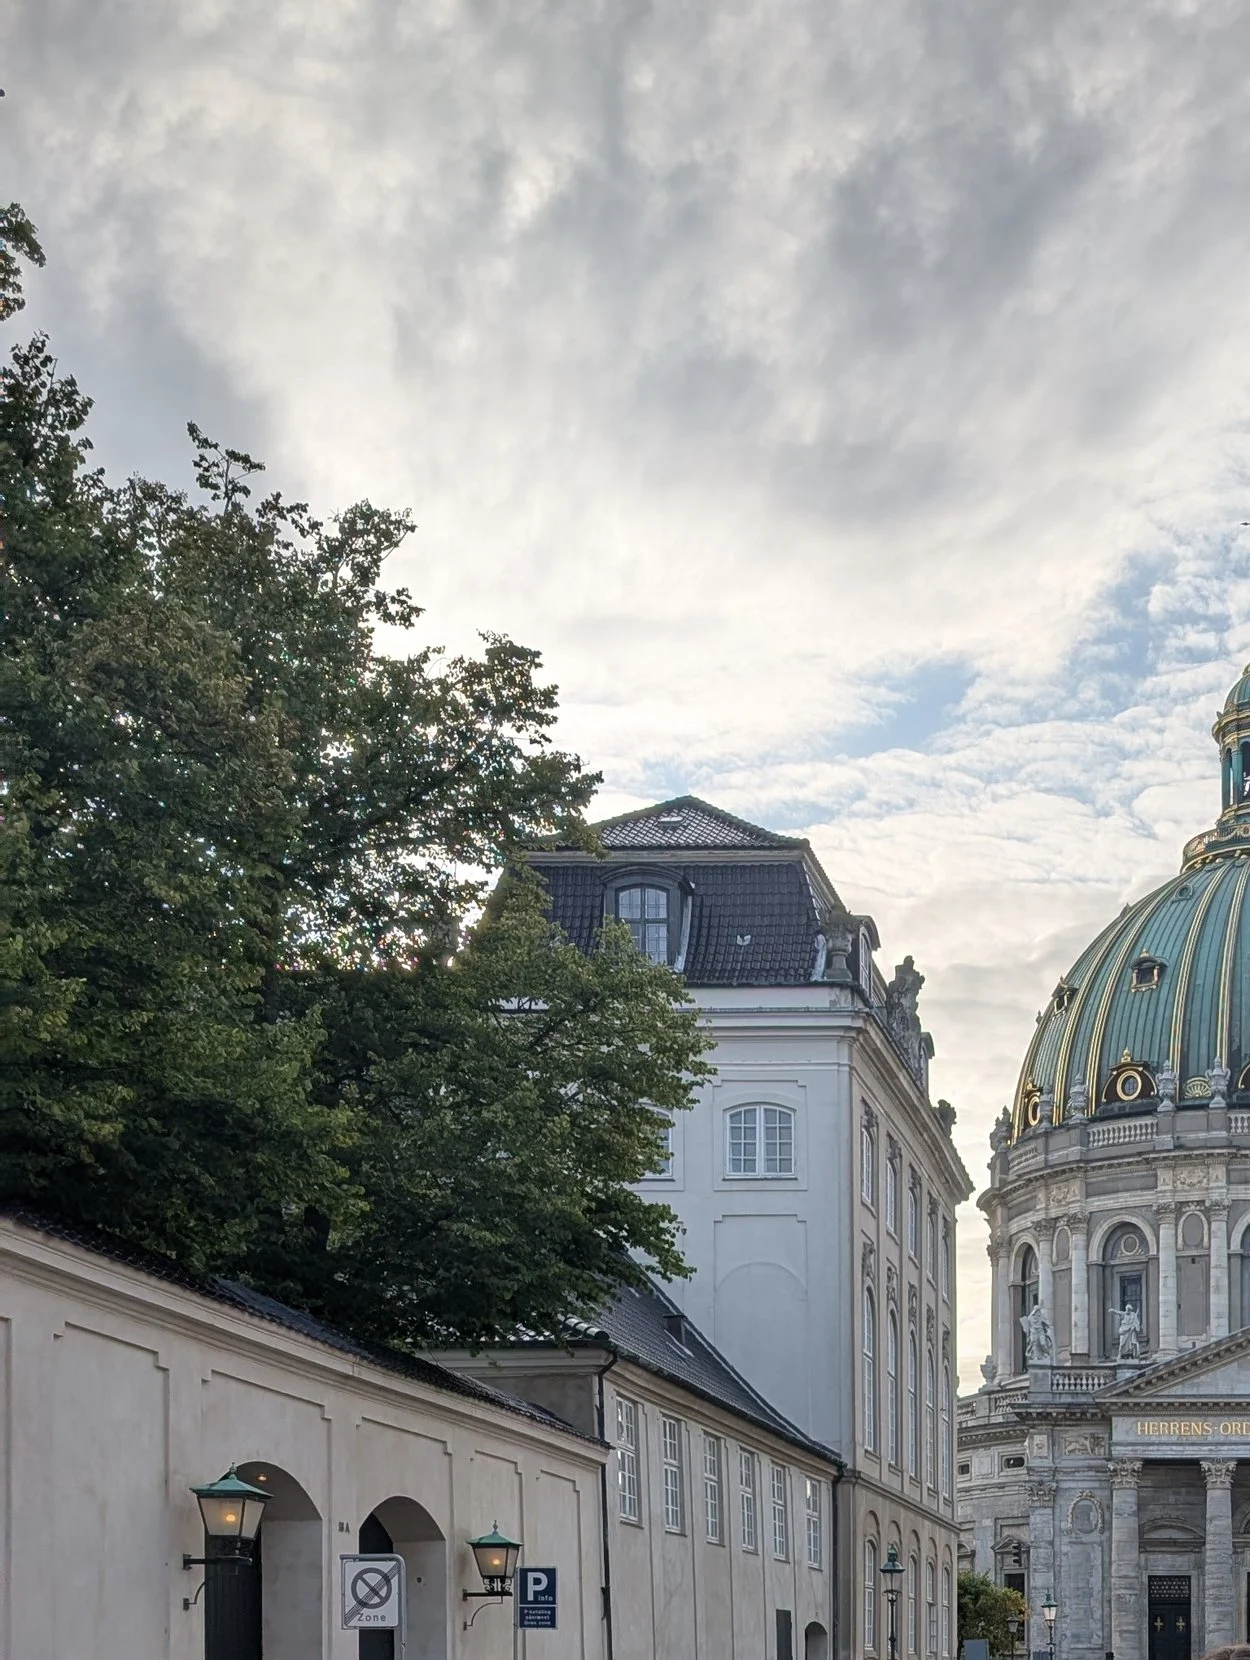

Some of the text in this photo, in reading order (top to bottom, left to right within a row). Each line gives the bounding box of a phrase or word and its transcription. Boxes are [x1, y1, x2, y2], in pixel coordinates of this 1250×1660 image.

[1137, 1421, 1213, 1435] HERRENS
[527, 1572, 548, 1601] P
[357, 1613, 387, 1622] Zone
